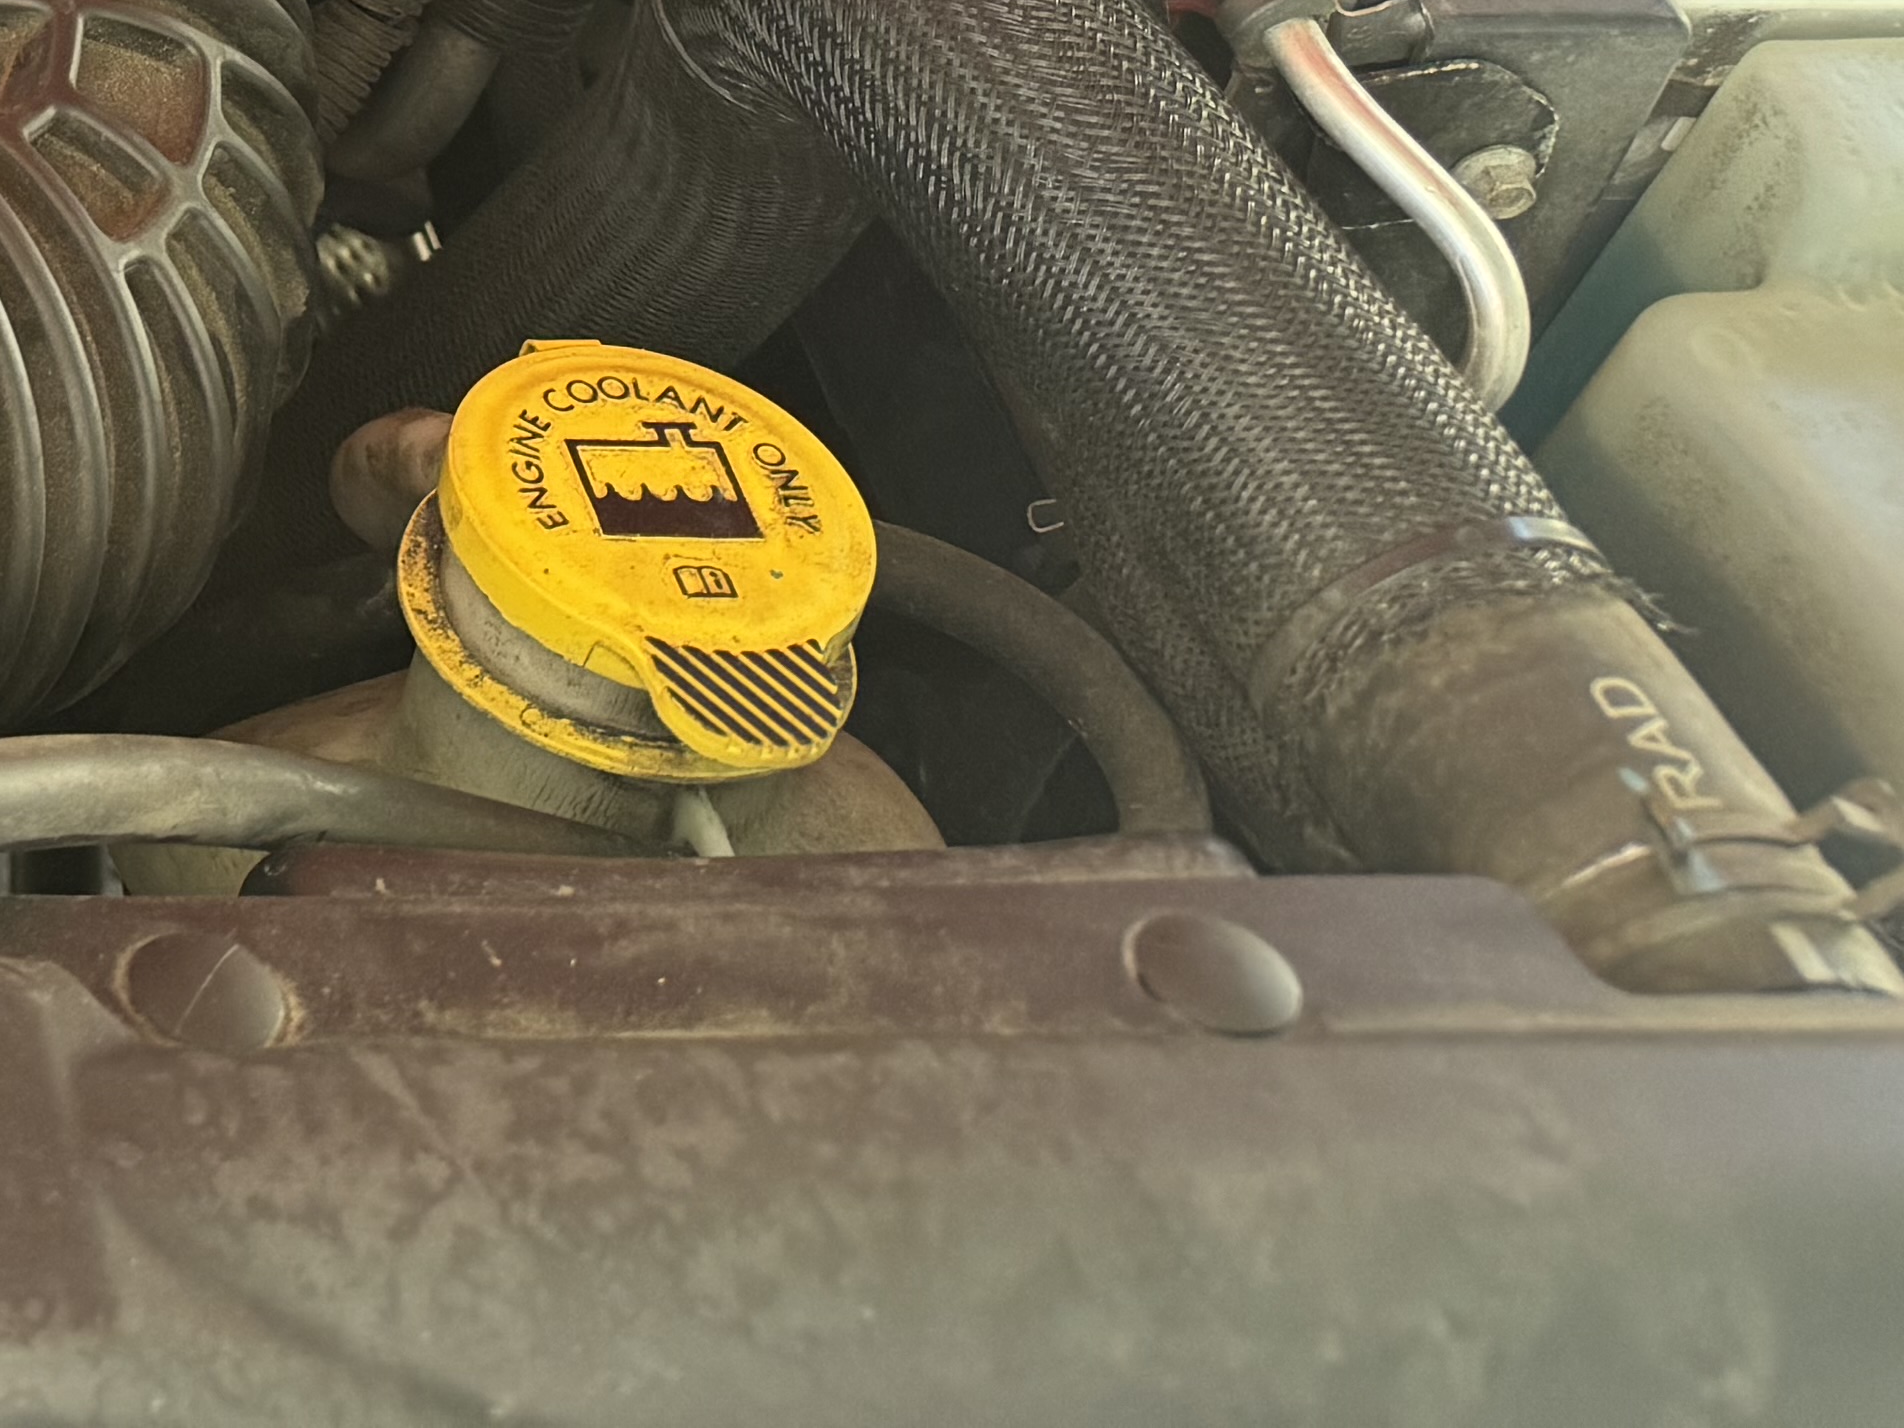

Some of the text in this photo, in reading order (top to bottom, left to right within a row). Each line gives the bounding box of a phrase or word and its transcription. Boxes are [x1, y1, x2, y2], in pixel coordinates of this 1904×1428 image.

[506, 375, 821, 537] ENGINE COOLANT ONLY
[1589, 676, 1725, 812] RAD
